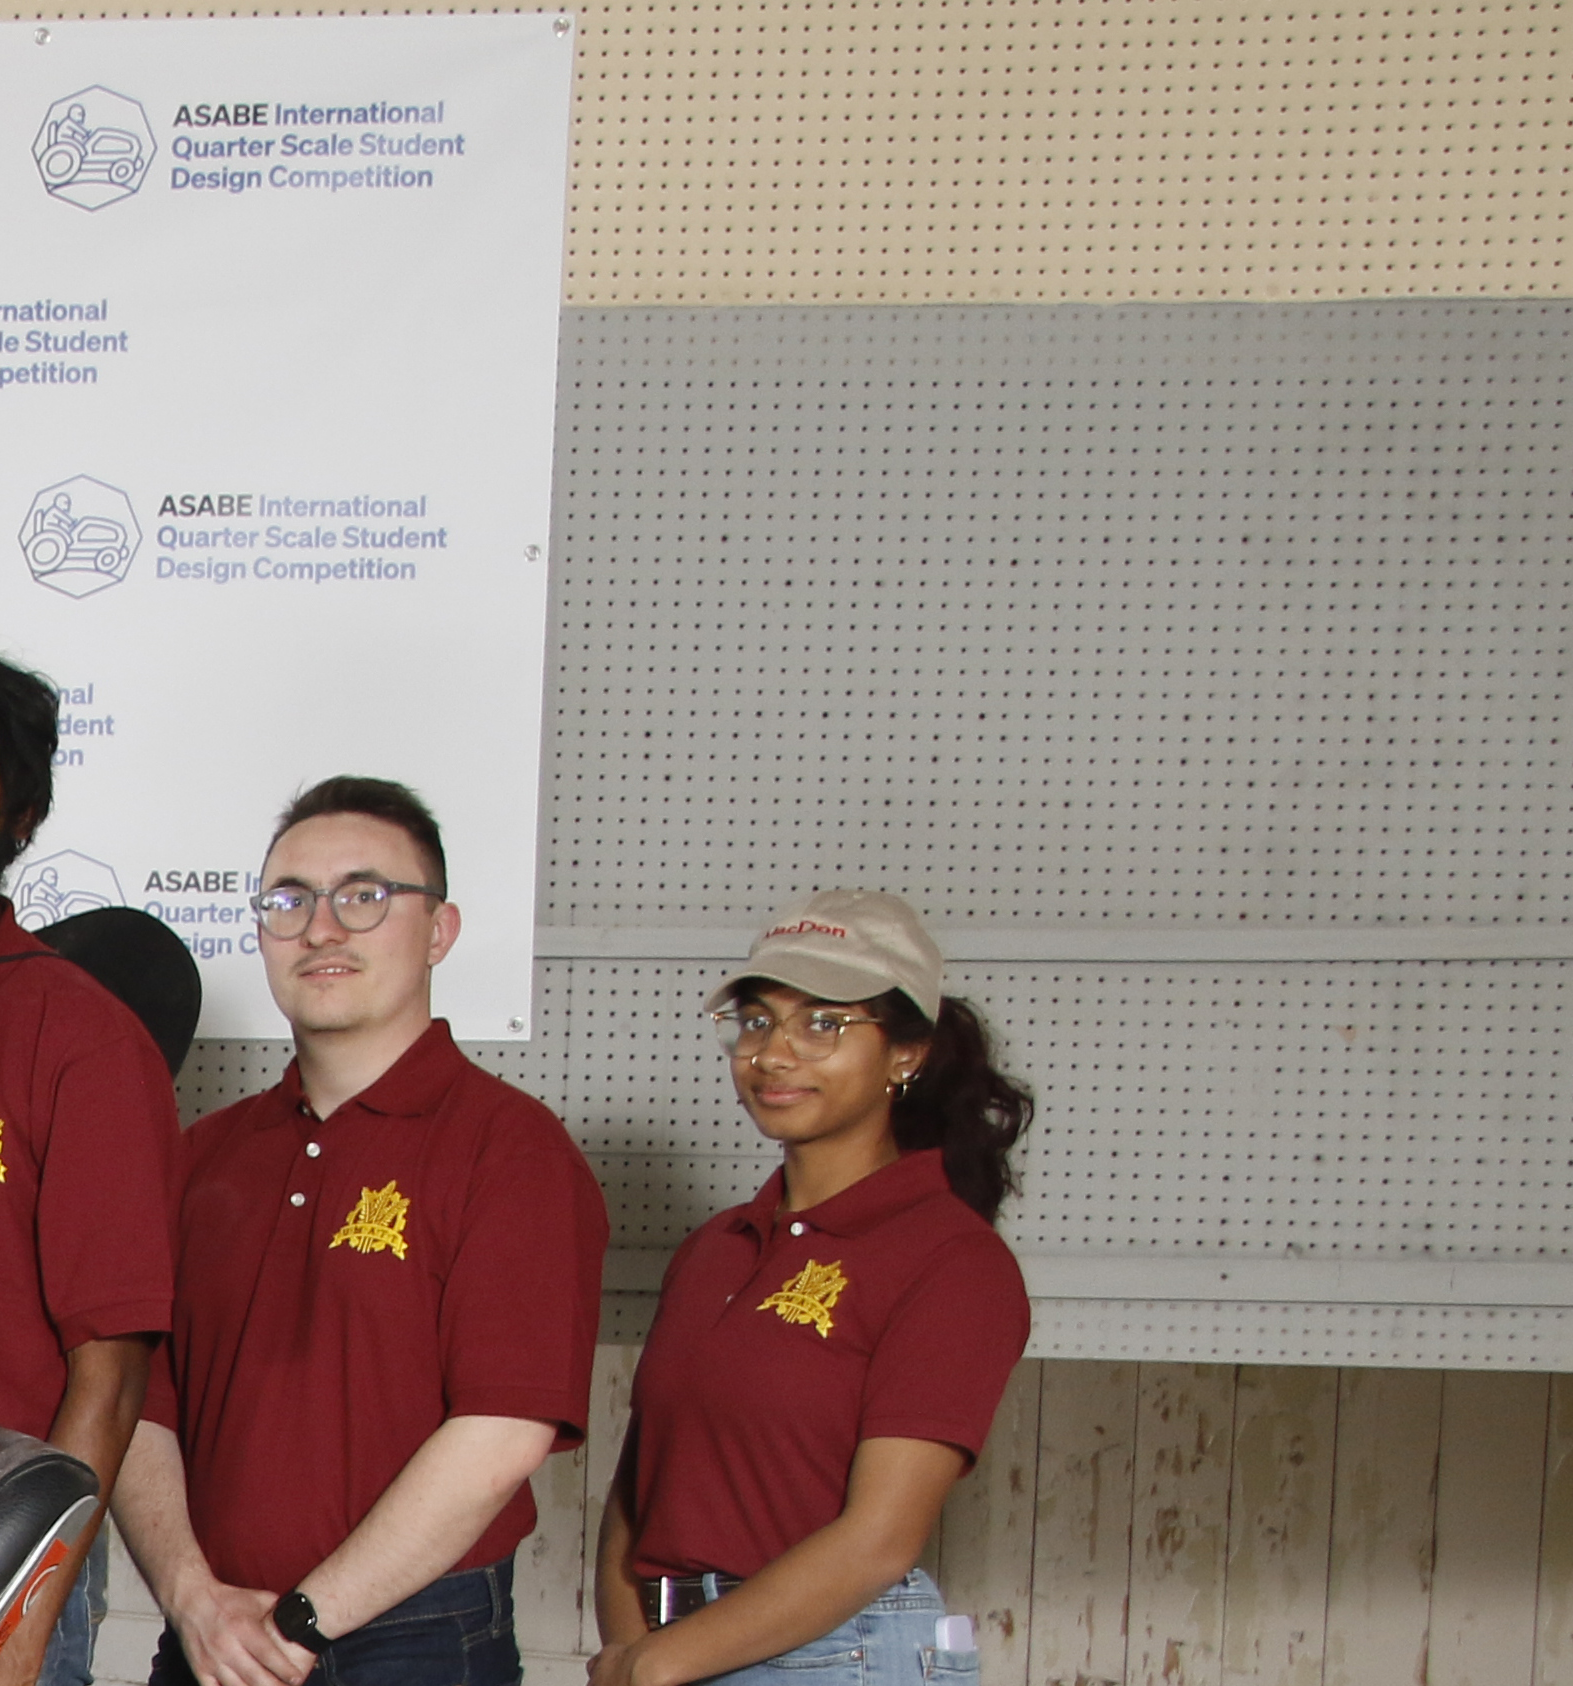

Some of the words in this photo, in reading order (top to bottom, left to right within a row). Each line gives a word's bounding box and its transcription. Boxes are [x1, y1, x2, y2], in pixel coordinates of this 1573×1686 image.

[172, 103, 269, 128] ASABE
[275, 100, 444, 126] International
[171, 136, 276, 162] Quarter
[280, 133, 353, 156] Scale
[359, 132, 465, 155] Student
[171, 166, 262, 194] Design
[269, 165, 433, 192] Competition
[25, 330, 128, 352] Student
[158, 494, 253, 517] ASABE
[260, 495, 426, 517] International
[157, 525, 259, 551] Quarter
[265, 526, 336, 548] Scale
[342, 526, 447, 548] Student
[157, 557, 246, 584] Design
[253, 557, 415, 584] Competition
[144, 871, 239, 893] ASABE
